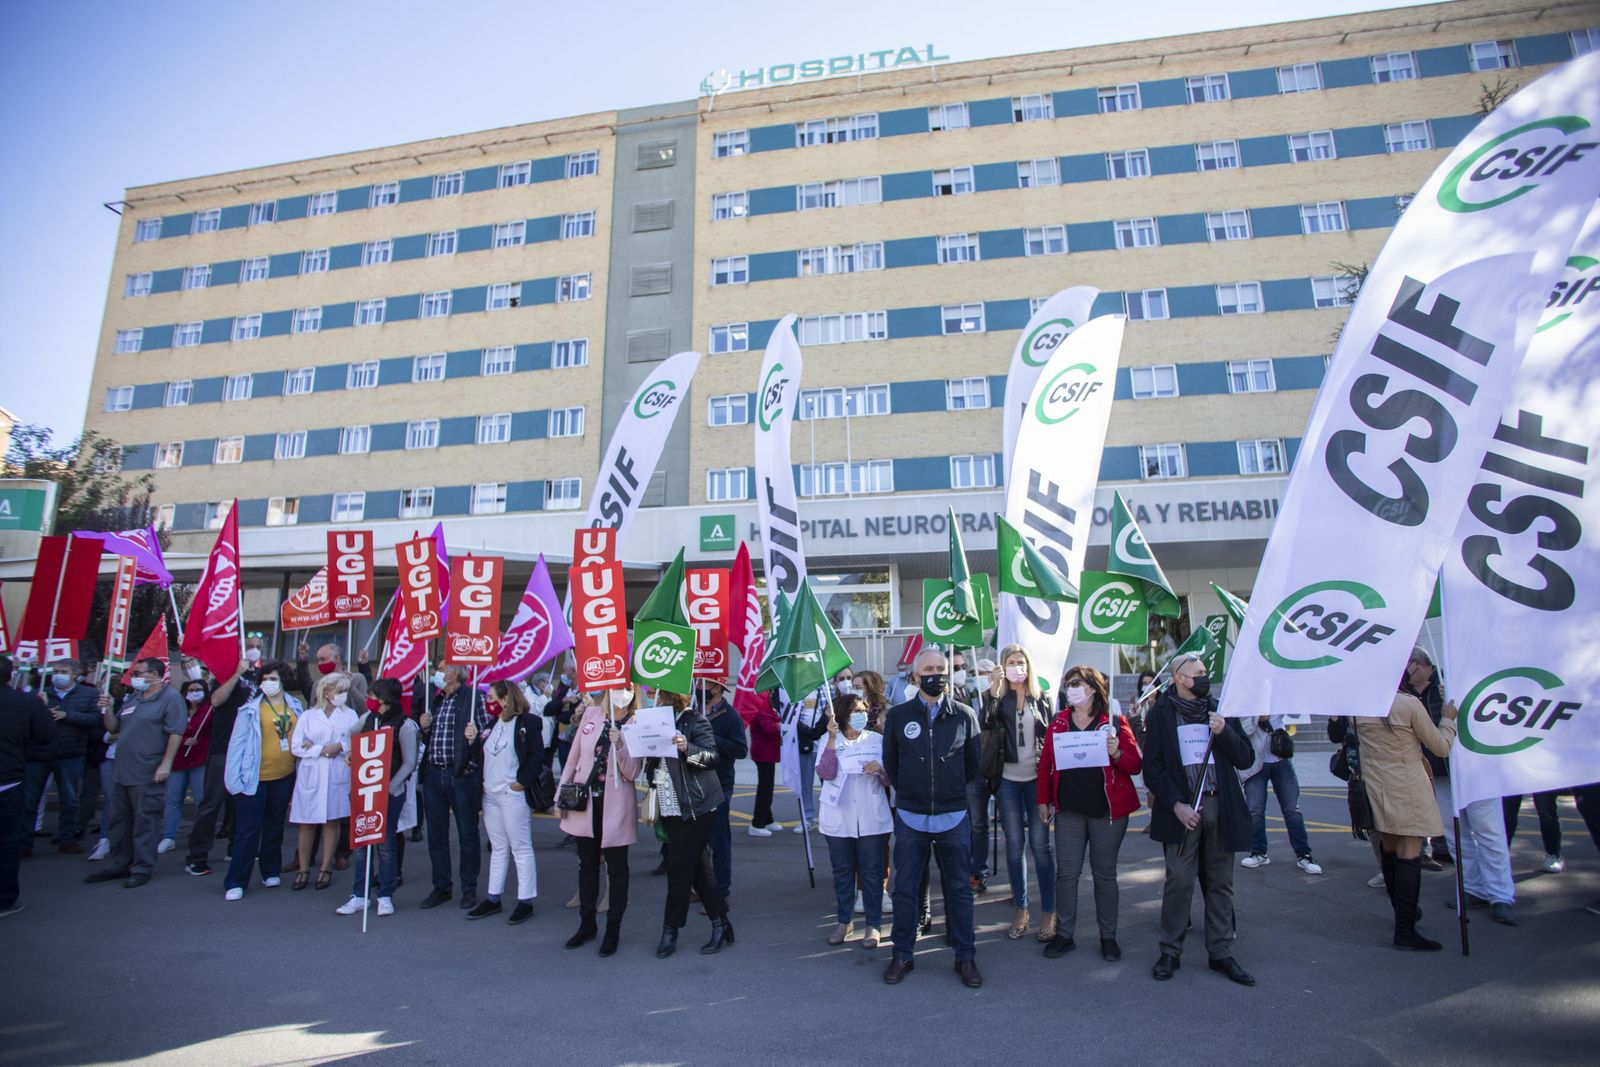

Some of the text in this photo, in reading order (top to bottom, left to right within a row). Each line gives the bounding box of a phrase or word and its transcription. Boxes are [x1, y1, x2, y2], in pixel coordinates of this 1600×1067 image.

[740, 44, 949, 88] HOSPITAL
[1470, 142, 1600, 181] CSIF
[1545, 276, 1600, 308] SIF
[643, 391, 677, 410] CSIF
[1048, 382, 1104, 404] CSIF
[1325, 275, 1496, 527] CSIF
[591, 446, 639, 534] SIF
[750, 518, 858, 542] HPITAL
[1155, 503, 1171, 524] Y
[336, 533, 366, 595] UGT
[405, 541, 432, 612] UGT
[460, 560, 494, 634] UGT
[581, 568, 617, 655] UGT
[689, 573, 720, 647] UGT
[1093, 597, 1140, 618] CSIF
[1283, 604, 1395, 652] CSIF
[645, 643, 688, 666] CSIF
[1473, 693, 1583, 731] CSIF
[358, 733, 386, 812] UGT
